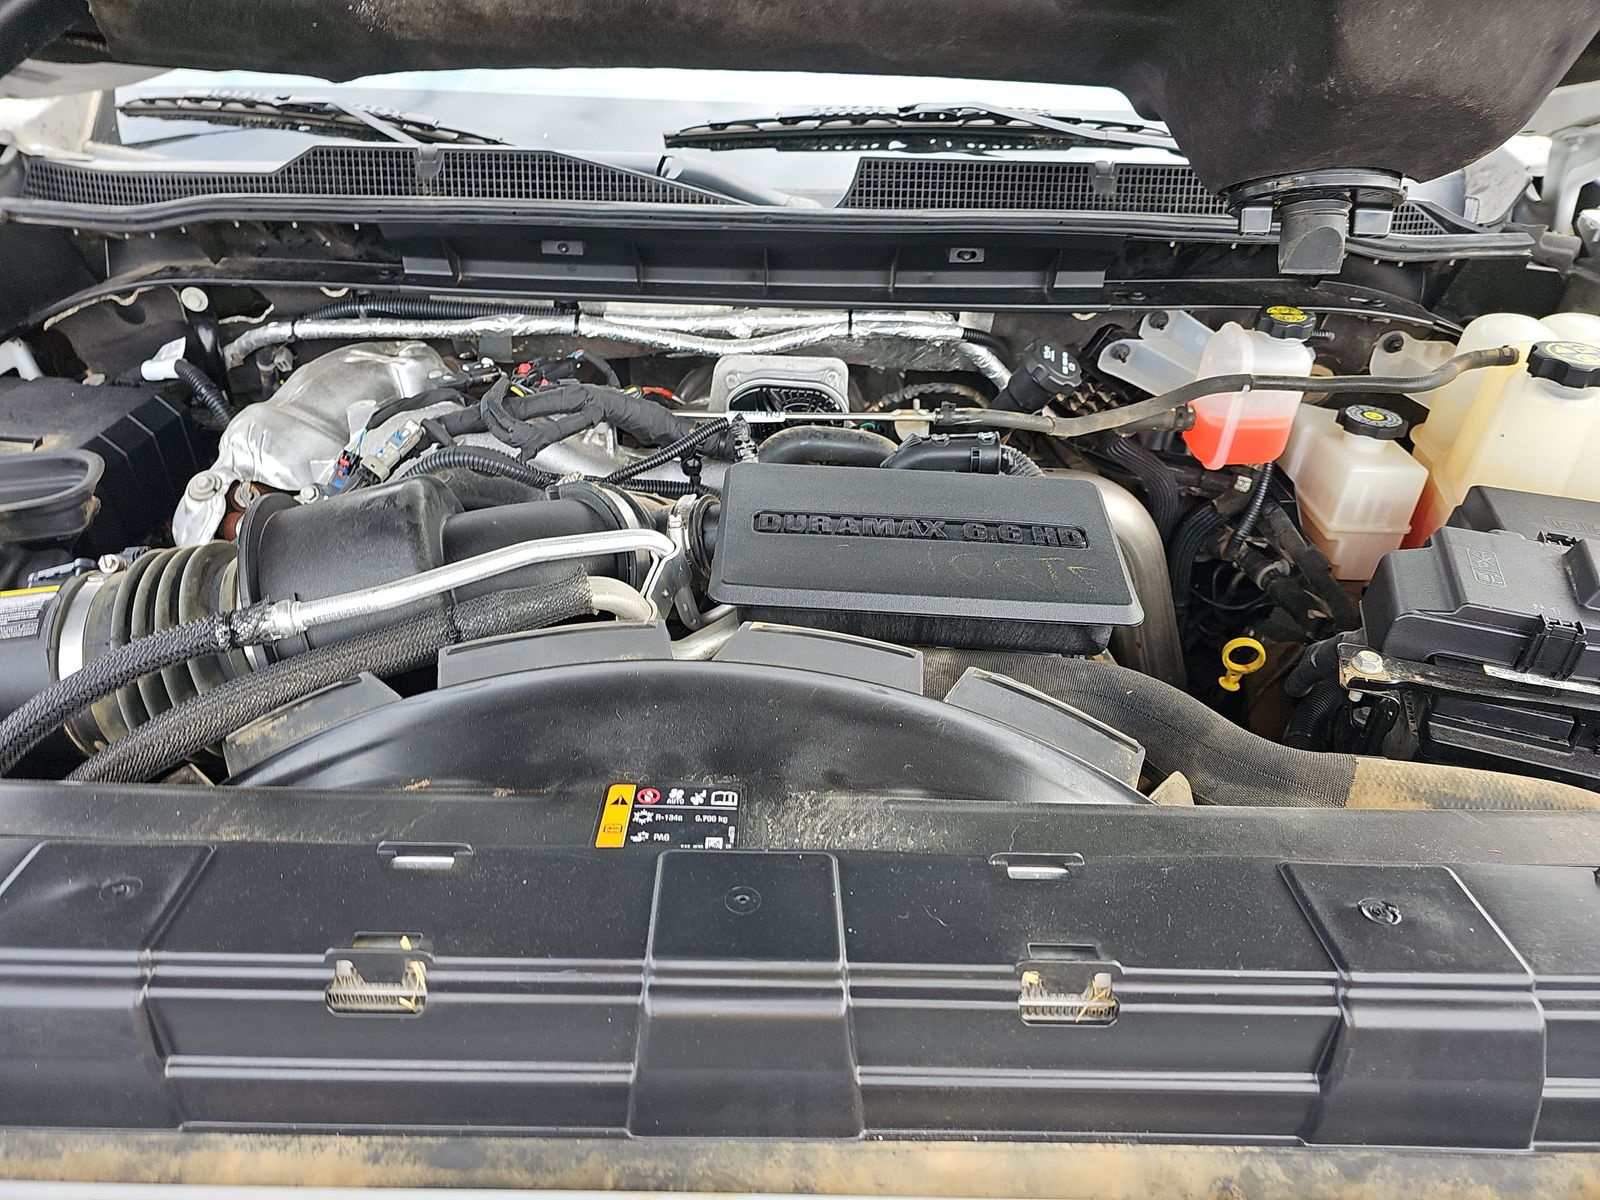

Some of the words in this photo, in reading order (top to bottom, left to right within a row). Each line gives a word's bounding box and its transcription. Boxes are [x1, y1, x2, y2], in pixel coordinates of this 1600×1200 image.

[759, 513, 948, 539] DURAMAX
[962, 522, 1024, 544] 6.6
[1032, 526, 1086, 548] HD
[695, 814, 717, 823] 0.700
[718, 815, 728, 824] kg
